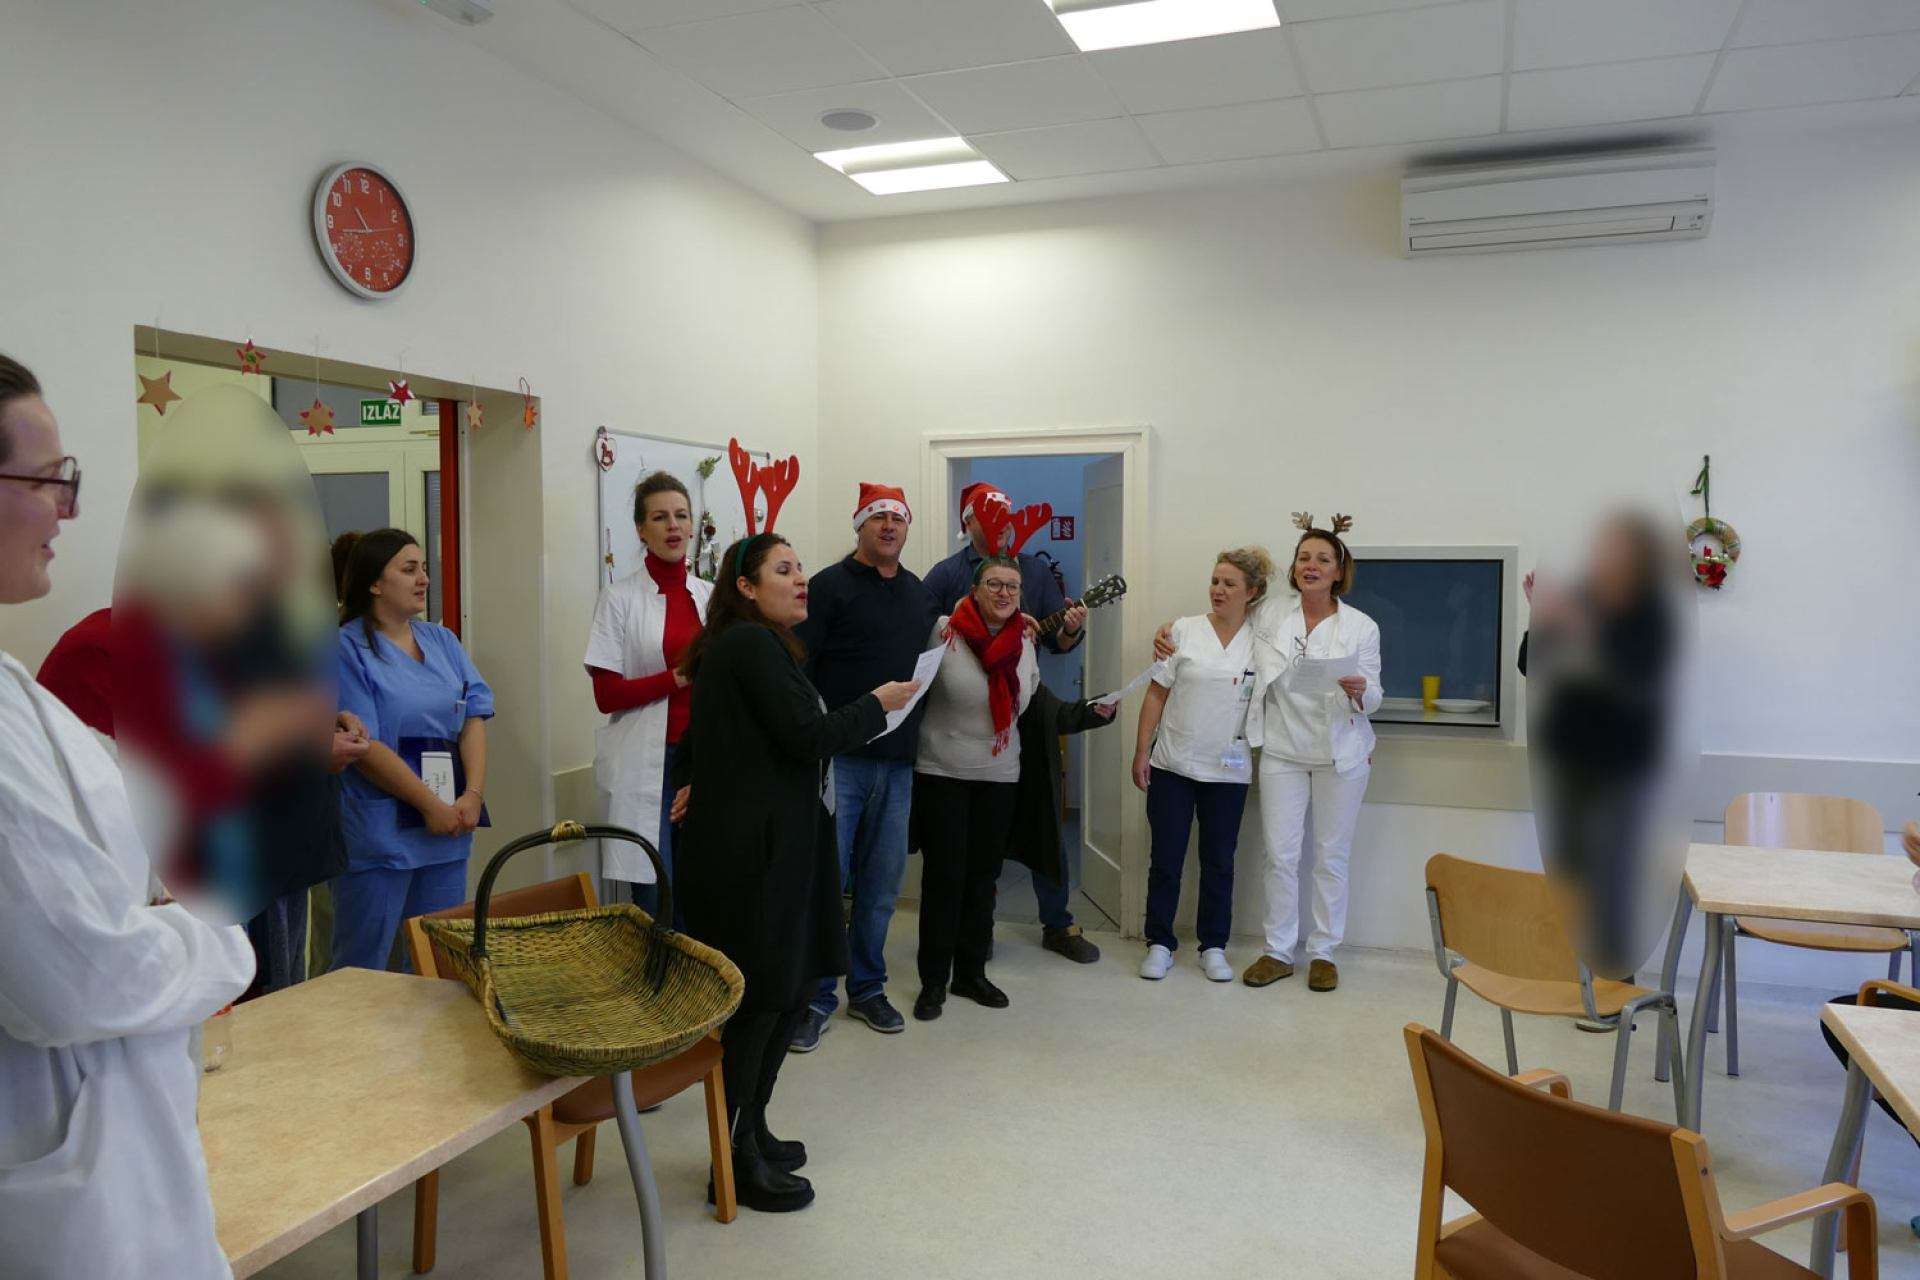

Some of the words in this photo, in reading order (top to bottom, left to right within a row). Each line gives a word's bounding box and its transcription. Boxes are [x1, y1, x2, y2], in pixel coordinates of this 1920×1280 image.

[344, 180, 352, 195] 11
[360, 179, 369, 194] 12
[333, 192, 342, 207] 10
[379, 190, 383, 203] 1
[391, 210, 398, 223] 2
[363, 404, 400, 420] IZLAZ
